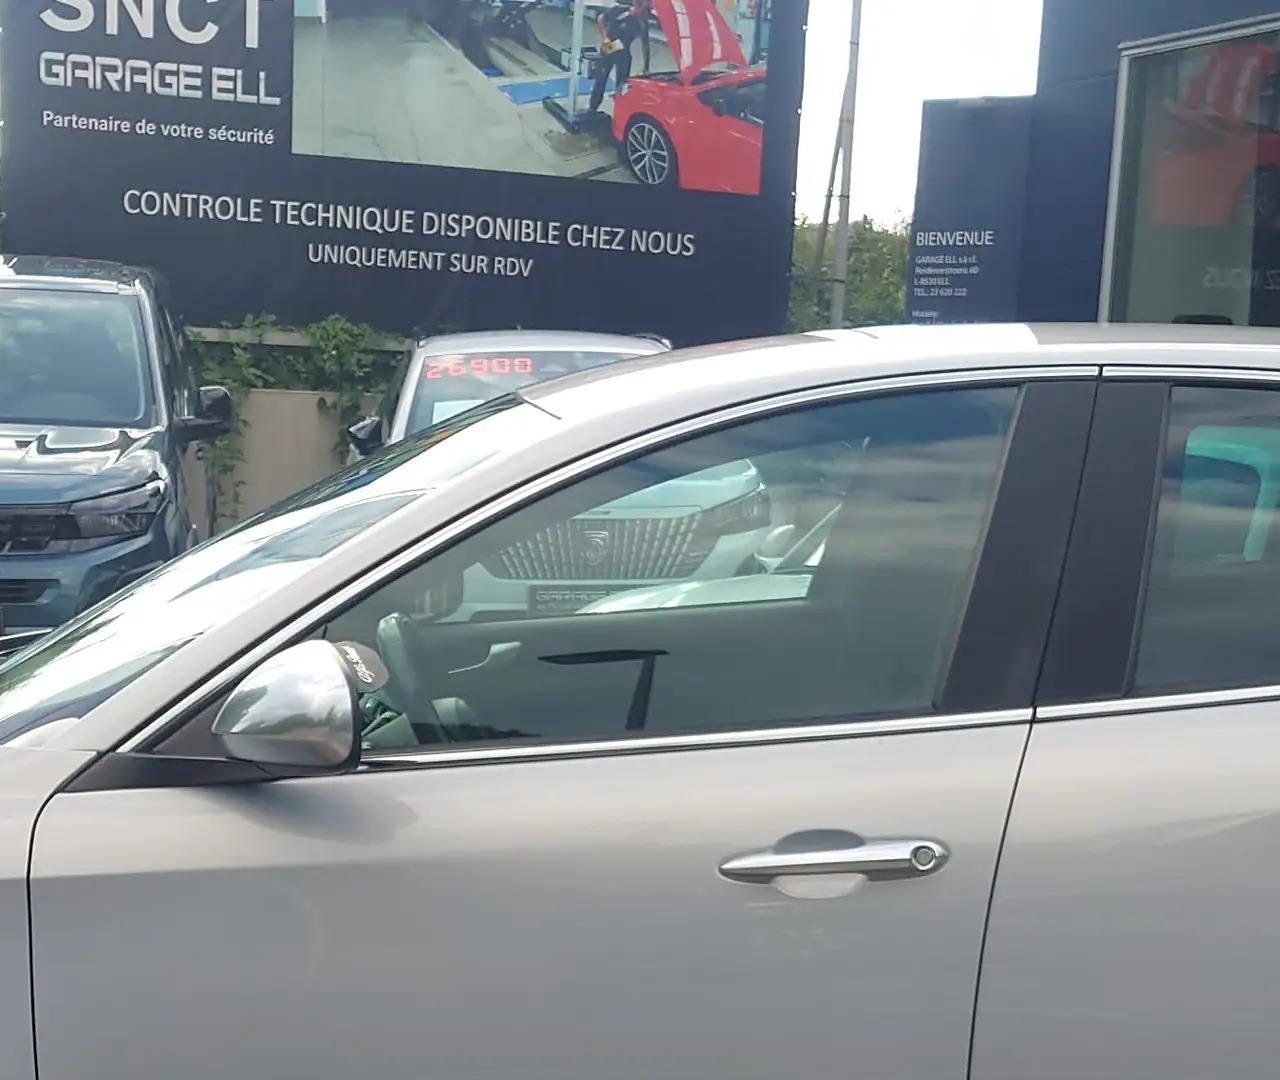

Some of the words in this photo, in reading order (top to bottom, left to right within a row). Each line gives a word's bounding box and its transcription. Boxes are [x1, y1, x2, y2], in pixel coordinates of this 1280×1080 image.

[39, 51, 203, 98] GARAGE
[211, 66, 281, 105] ELL
[42, 110, 131, 133] Partenaire
[135, 119, 156, 136] de
[160, 124, 203, 139] votre
[208, 126, 274, 145] sécurité
[123, 189, 263, 223] CONTROLE
[270, 199, 415, 234] TECHNIQUE
[422, 211, 561, 245] DISPONIBLE
[566, 223, 624, 251] CHEZ
[630, 229, 695, 256] NOUS
[916, 230, 995, 247] BIENVENUE
[308, 243, 446, 272] UNIQUEMENT
[449, 253, 489, 274] SUR
[493, 257, 534, 277] RDV
